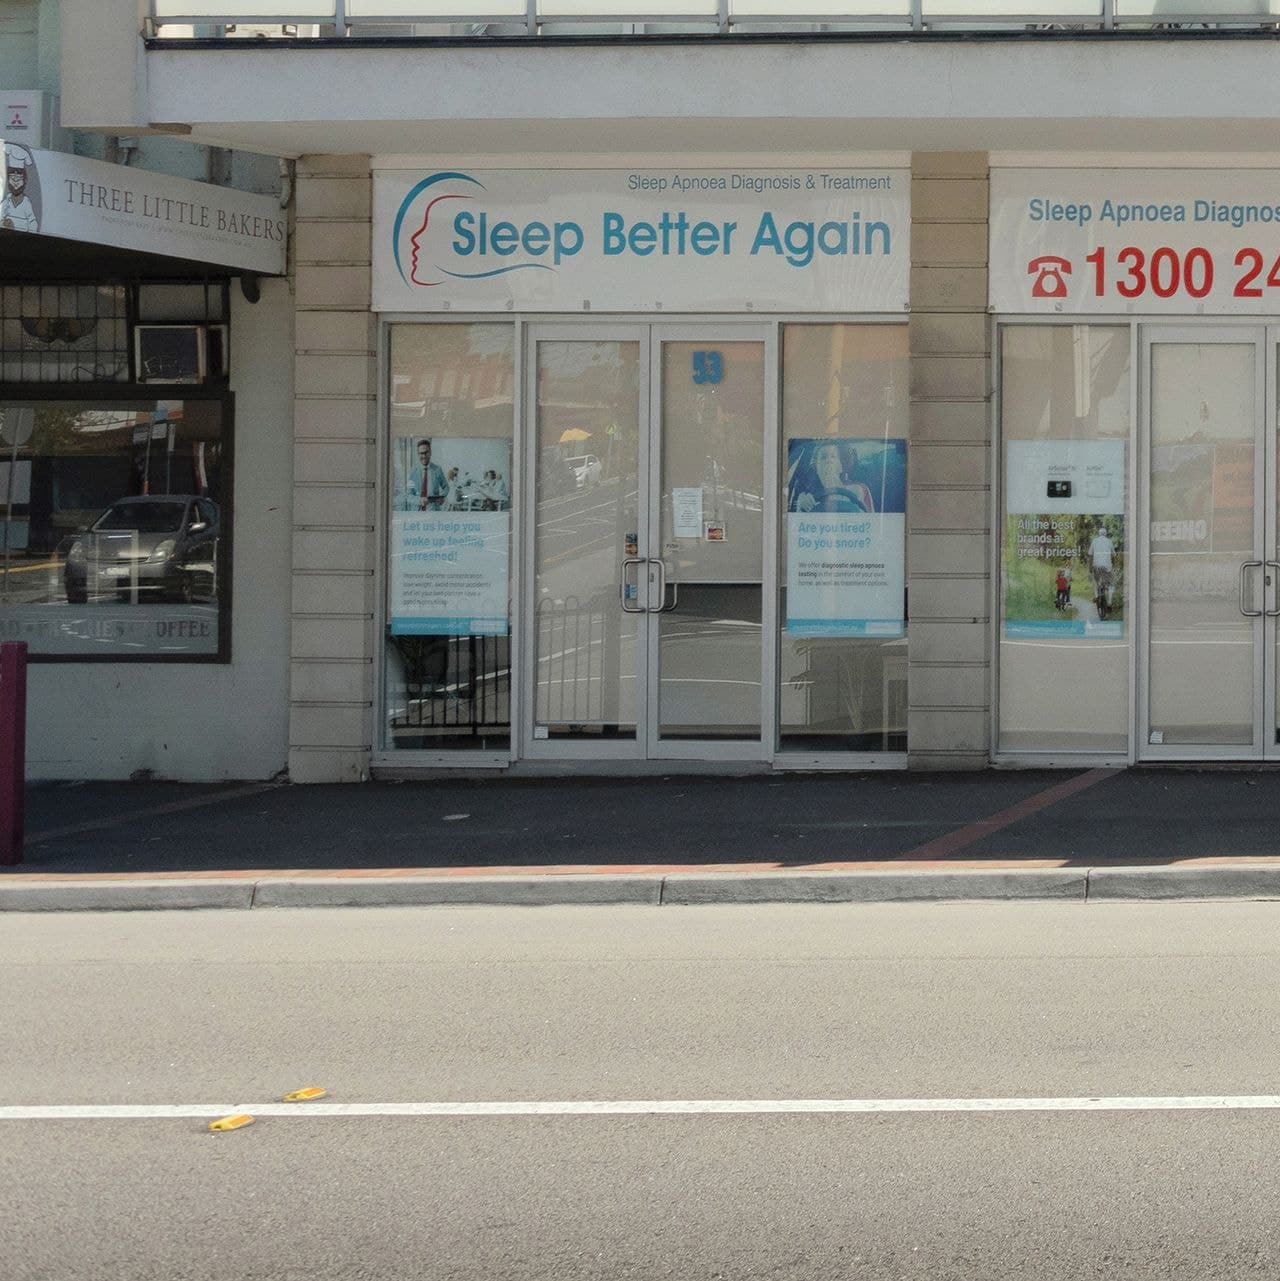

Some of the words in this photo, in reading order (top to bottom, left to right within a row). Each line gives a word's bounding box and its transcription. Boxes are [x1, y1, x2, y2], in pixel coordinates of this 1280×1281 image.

[628, 174, 668, 192] Sleep
[671, 175, 727, 192] Apnoea
[731, 175, 801, 192] Diagnosis
[805, 175, 816, 190] &
[820, 175, 891, 190] Treatment
[64, 179, 134, 214] THREE
[143, 195, 212, 228] LITTLE
[217, 209, 284, 242] BAKERS
[1028, 198, 1092, 227] Sleep
[1099, 199, 1186, 226] Apnoea
[452, 212, 584, 265] Sleep
[603, 212, 738, 257] Better
[750, 210, 891, 268] Again
[1086, 246, 1214, 298] 1300
[692, 350, 724, 384] 53
[798, 522, 818, 533] Are
[820, 524, 837, 535] you
[839, 522, 872, 533] tired?
[1052, 519, 1074, 530] best
[798, 538, 812, 549] Do
[814, 540, 833, 551] you
[837, 538, 871, 549] snore?
